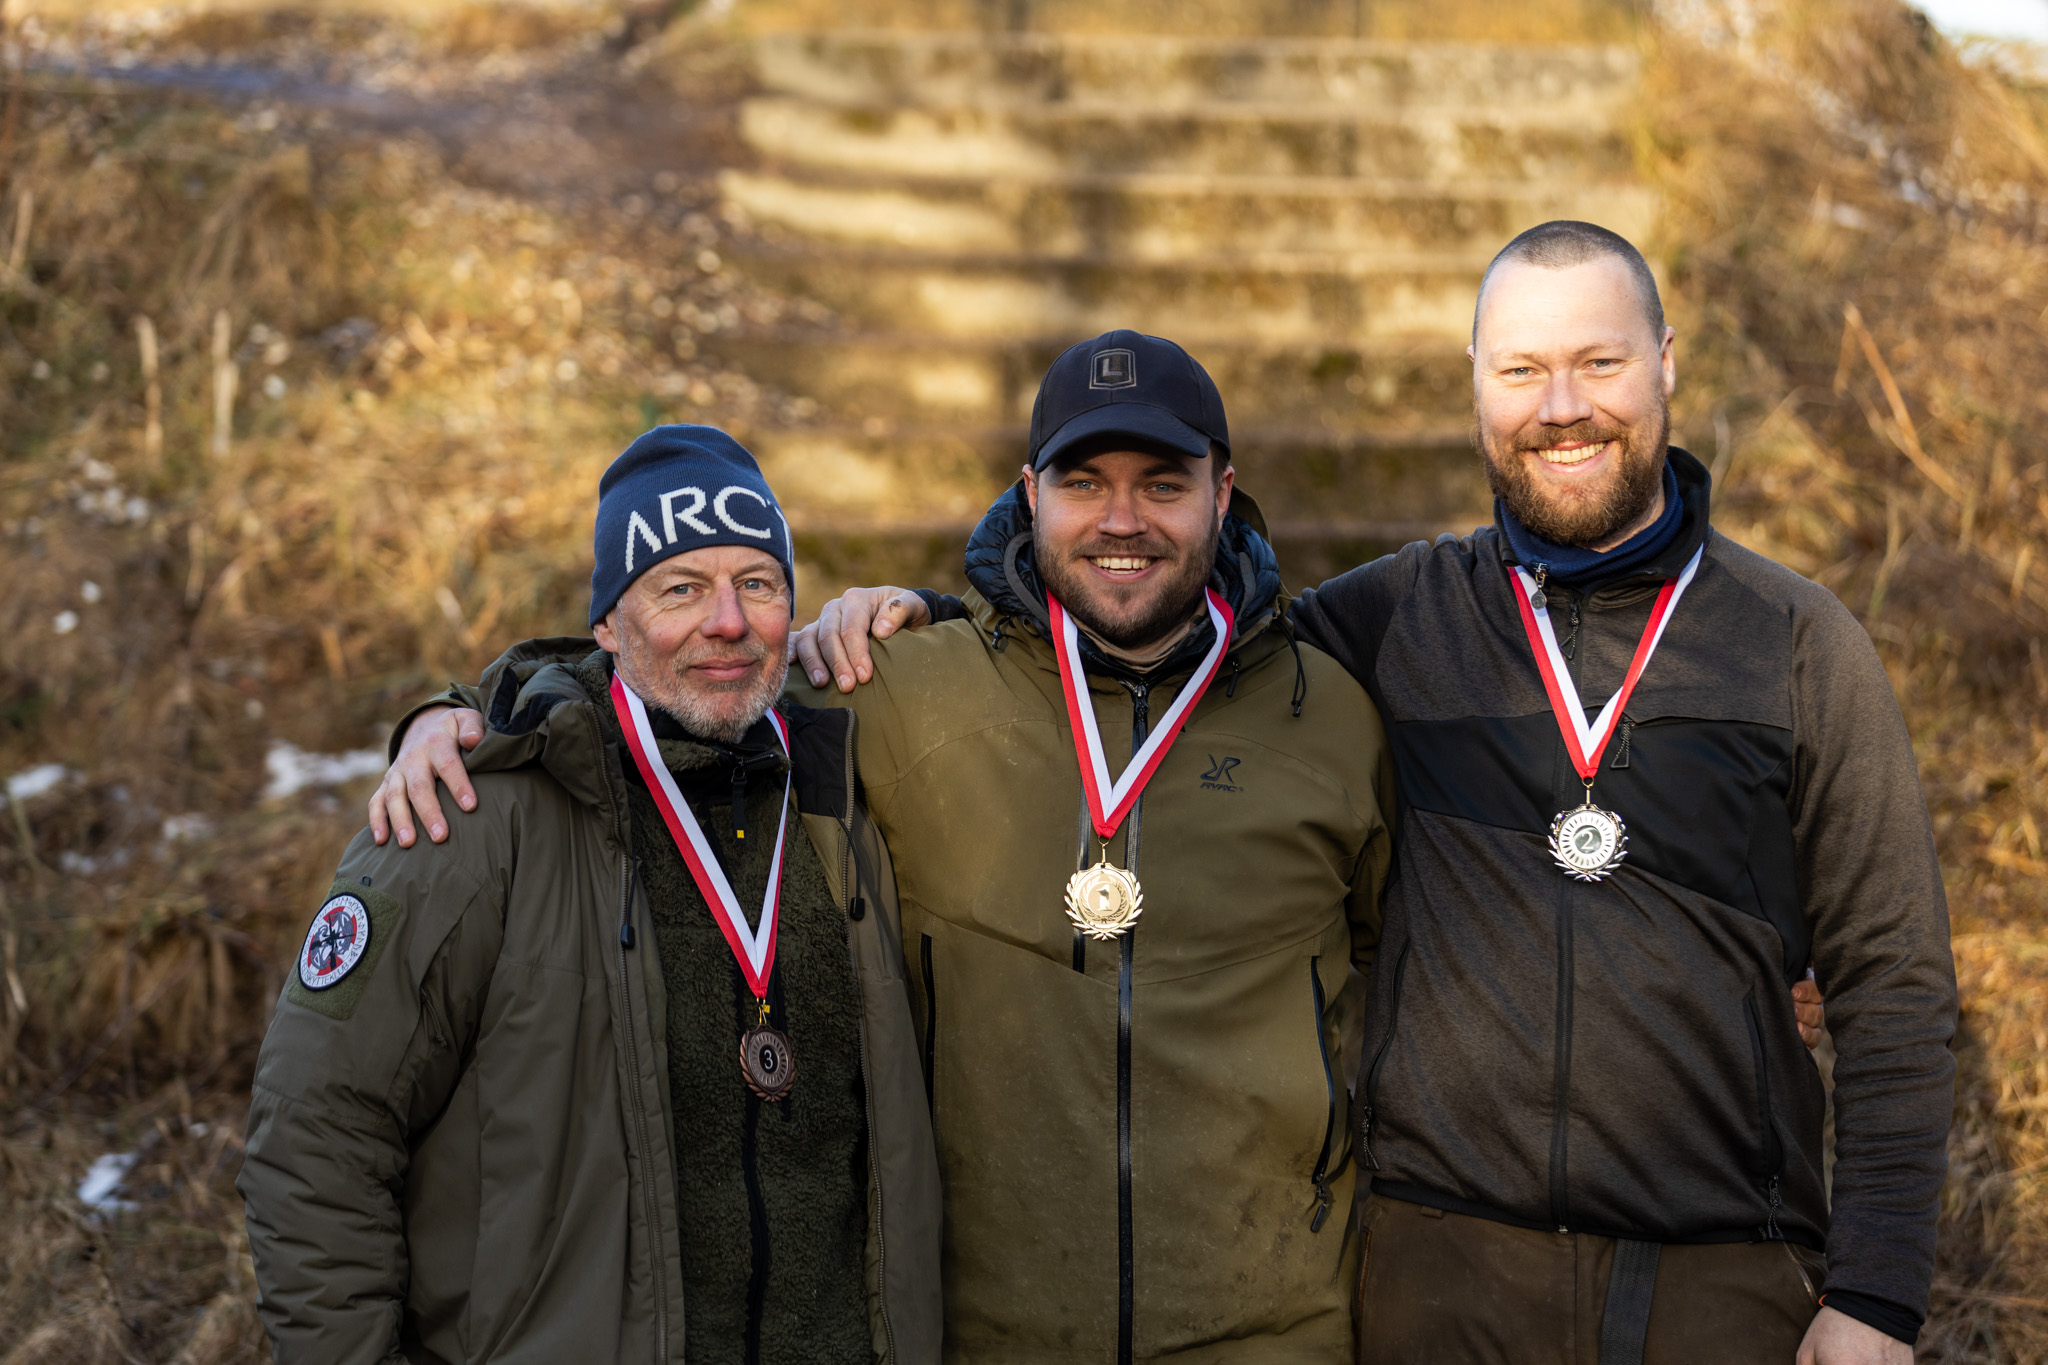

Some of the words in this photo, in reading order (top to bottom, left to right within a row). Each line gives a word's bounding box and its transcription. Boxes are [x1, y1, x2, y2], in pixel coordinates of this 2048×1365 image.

[1102, 358, 1123, 377] L
[1580, 830, 1595, 850] 2
[1096, 884, 1113, 911] 1
[764, 1049, 774, 1070] 3
